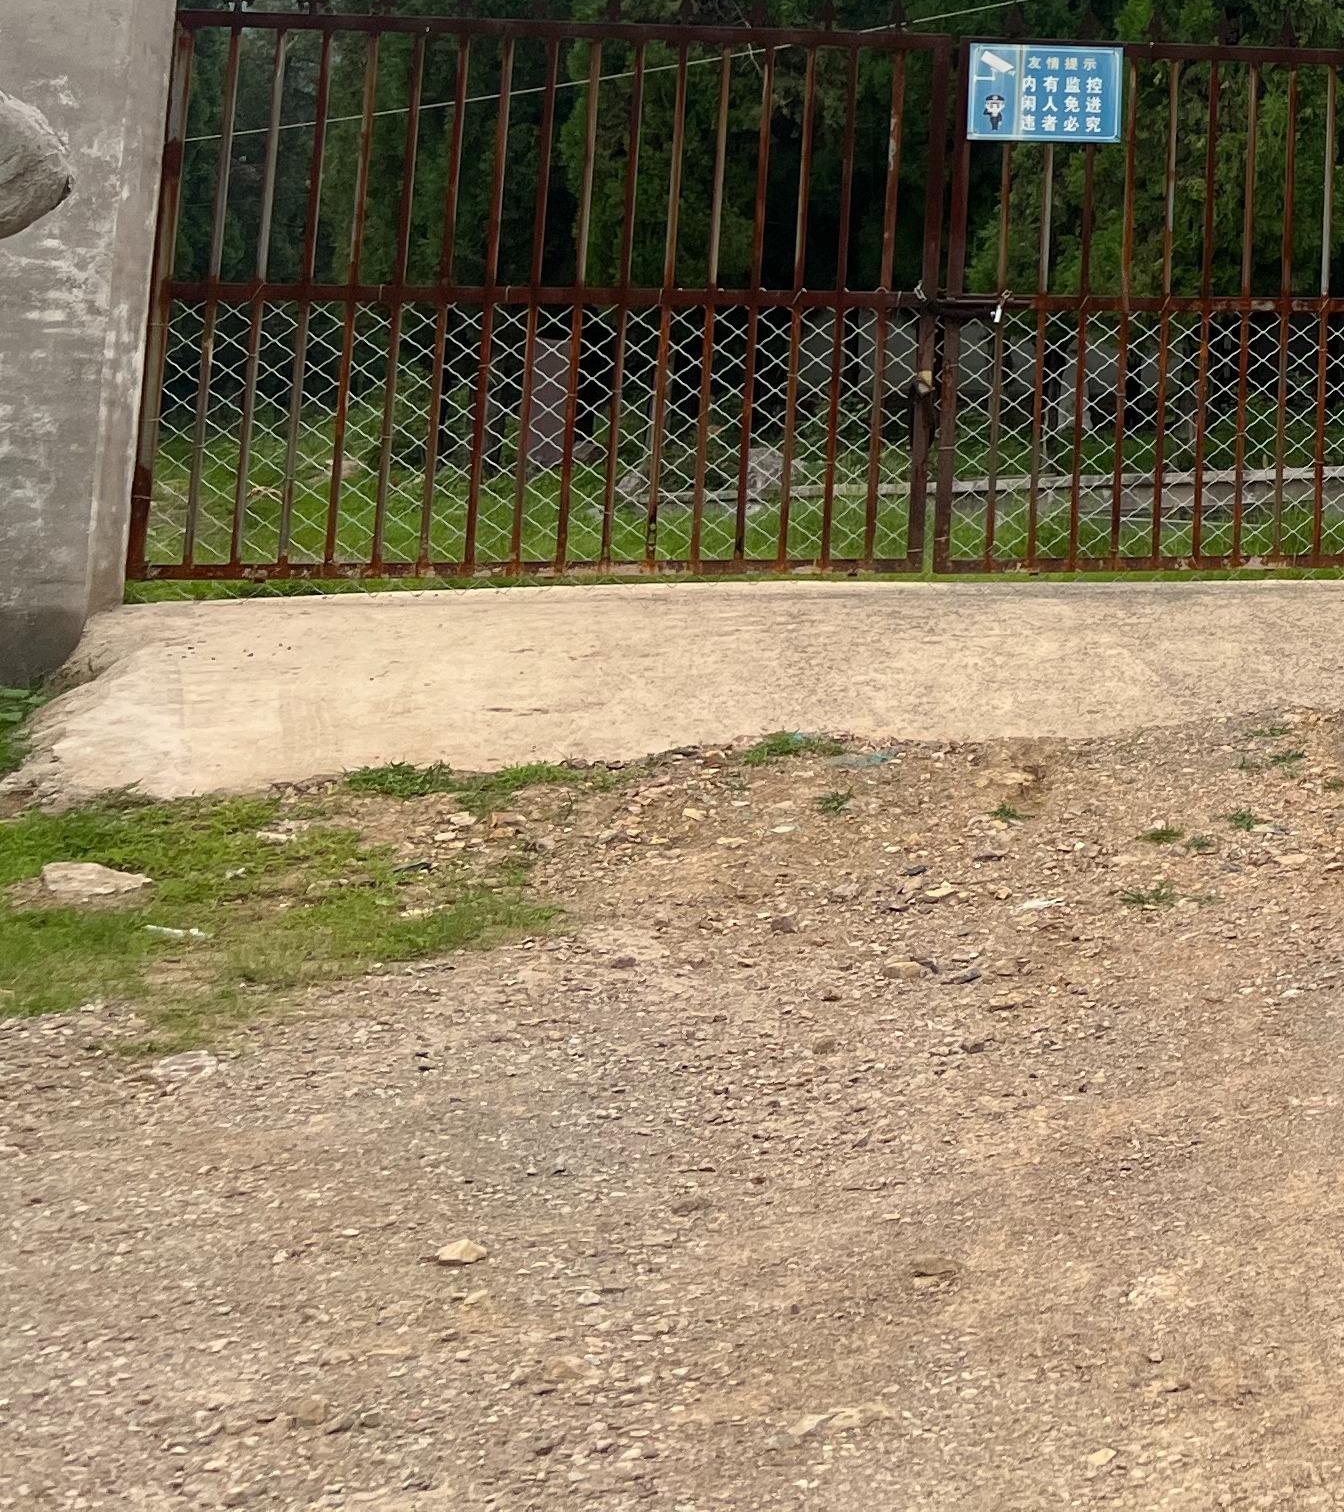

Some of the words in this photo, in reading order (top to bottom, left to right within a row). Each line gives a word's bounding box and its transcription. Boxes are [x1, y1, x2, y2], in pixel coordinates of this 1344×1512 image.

[1028, 56, 1097, 71] 友情提示
[1022, 76, 1103, 94] 内有监控
[1021, 95, 1102, 113] 闲人免进
[1021, 114, 1102, 133] 违者必究
